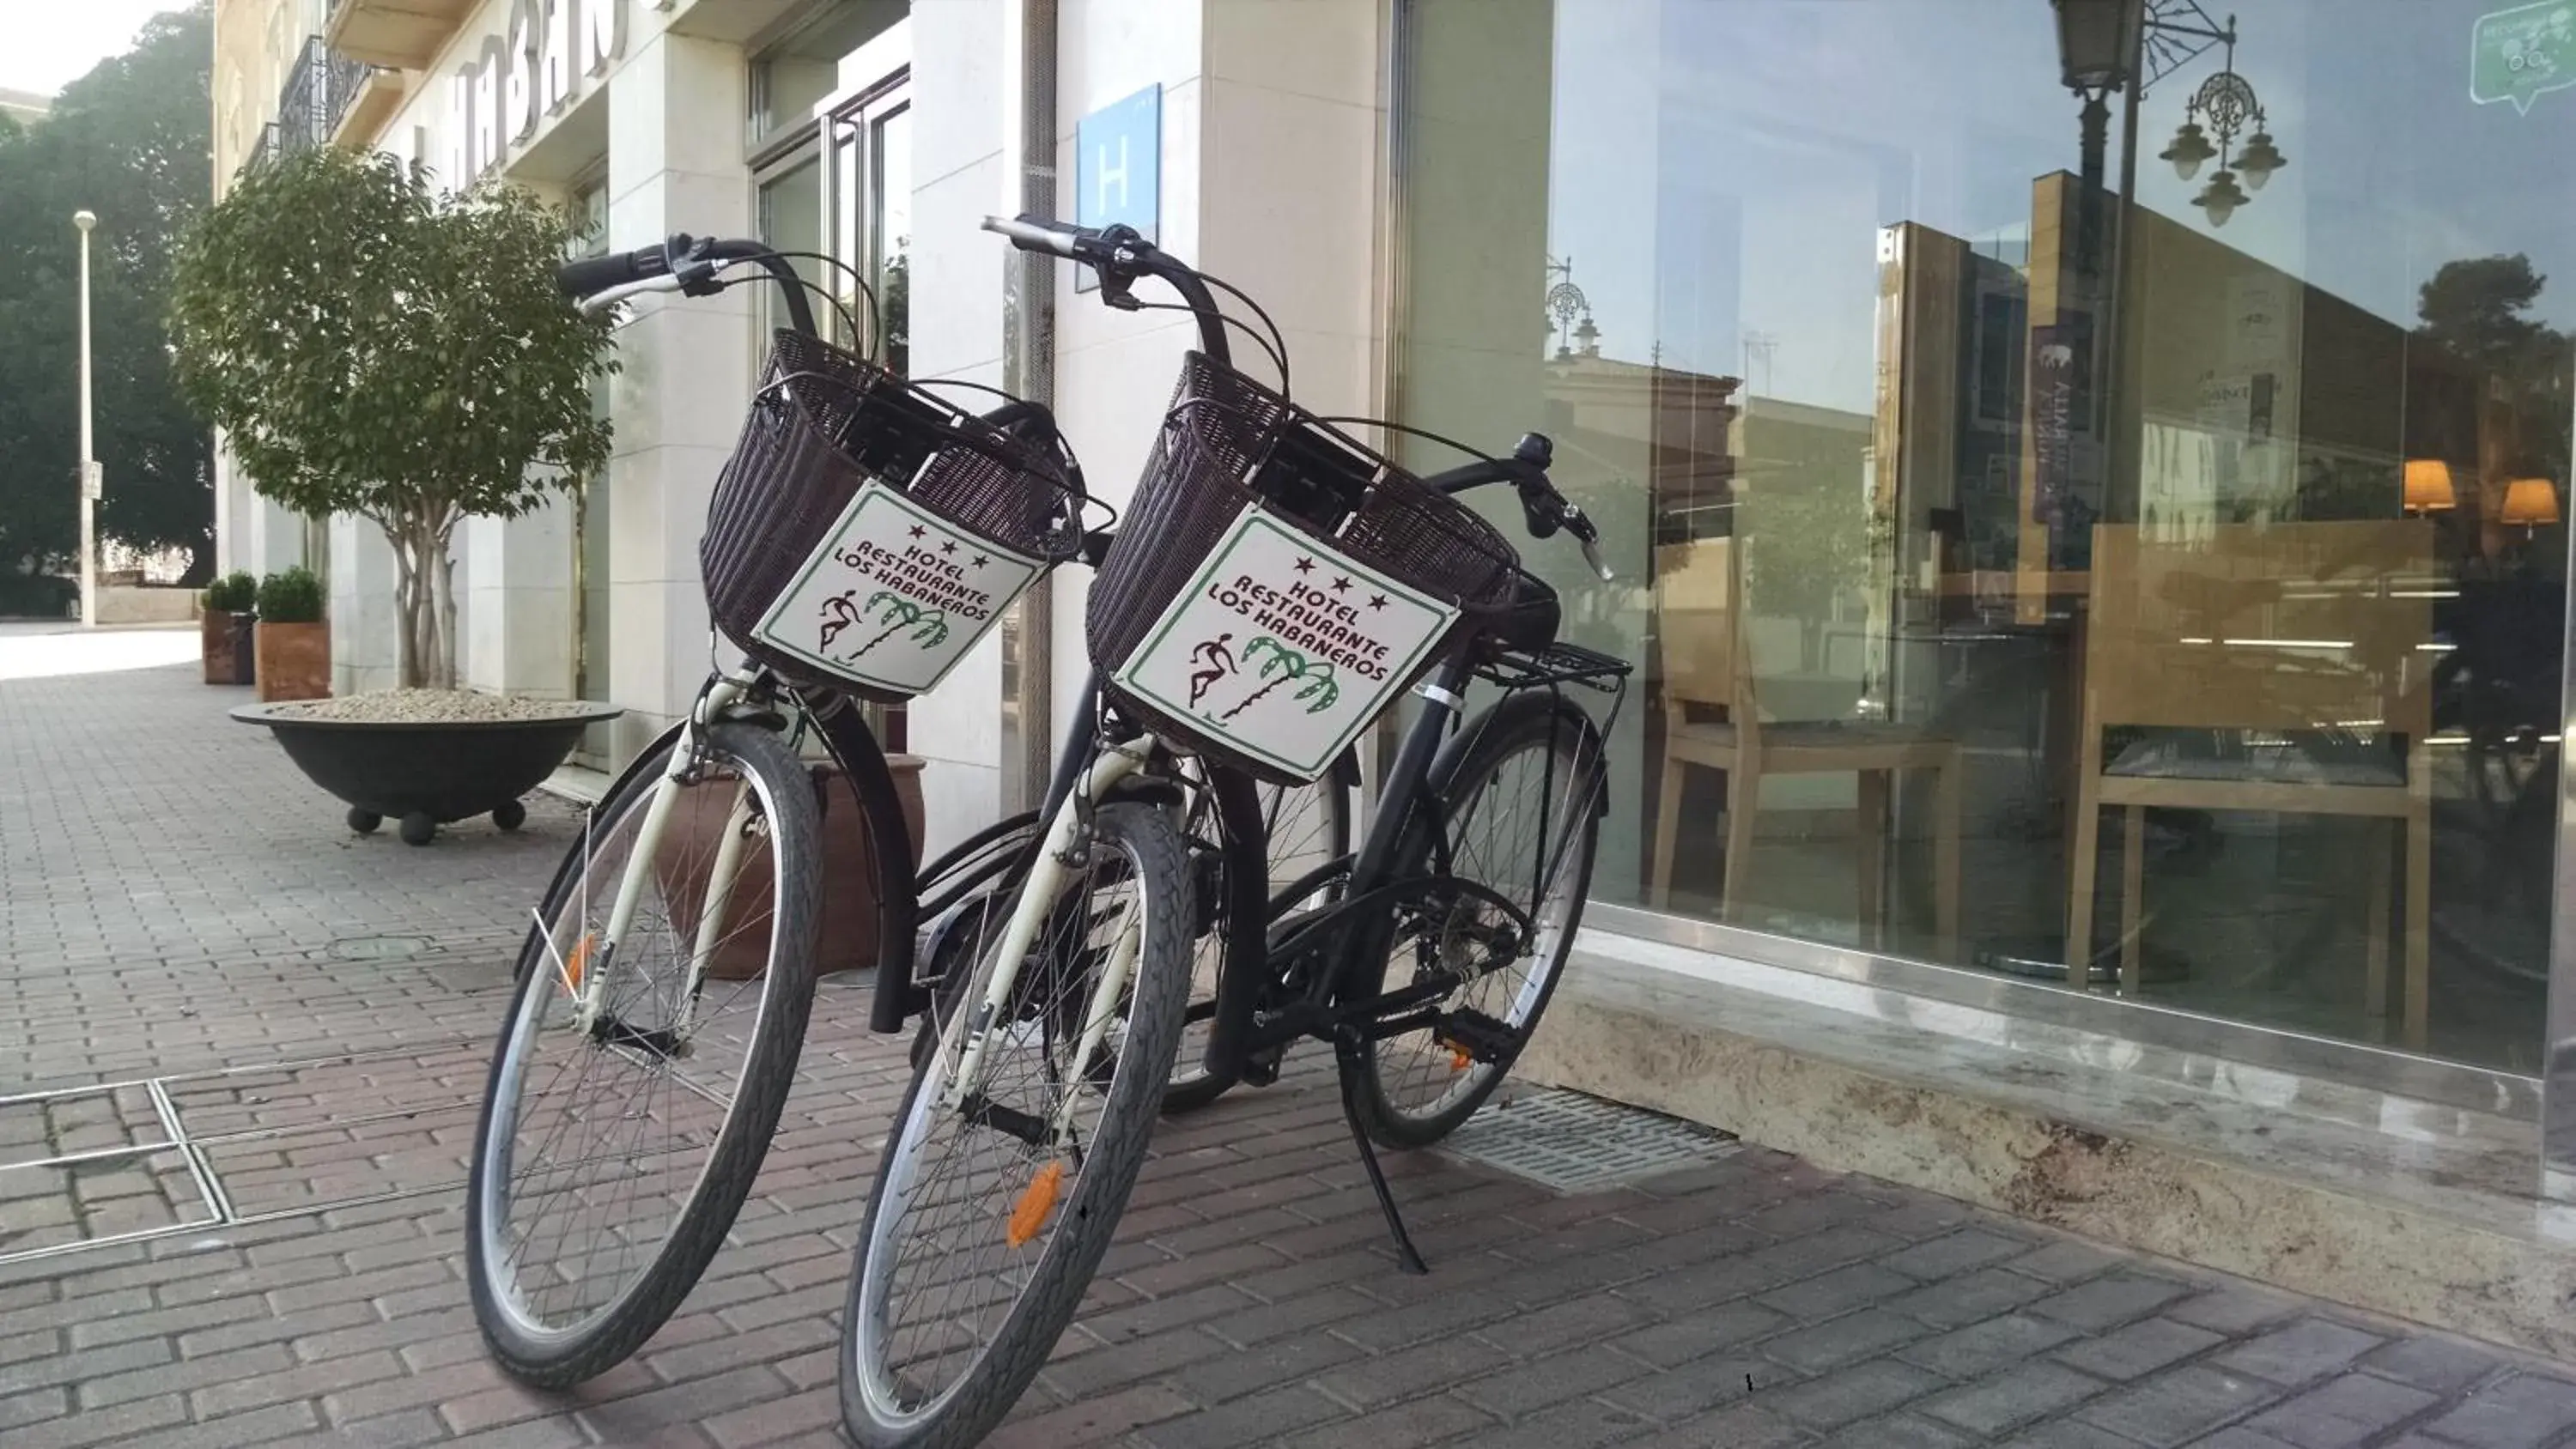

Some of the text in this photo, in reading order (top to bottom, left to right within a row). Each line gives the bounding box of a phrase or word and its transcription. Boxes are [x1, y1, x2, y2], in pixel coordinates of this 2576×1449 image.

[1098, 133, 1128, 218] H
[834, 547, 990, 621] LOS HABANEROS
[856, 541, 990, 606] RESTAURANTE
[904, 545, 964, 581] HOTEL
[1208, 583, 1389, 682] LOS HABANEROS
[1234, 574, 1390, 661] RESTAURANTE
[1288, 580, 1359, 626] HOTEL
